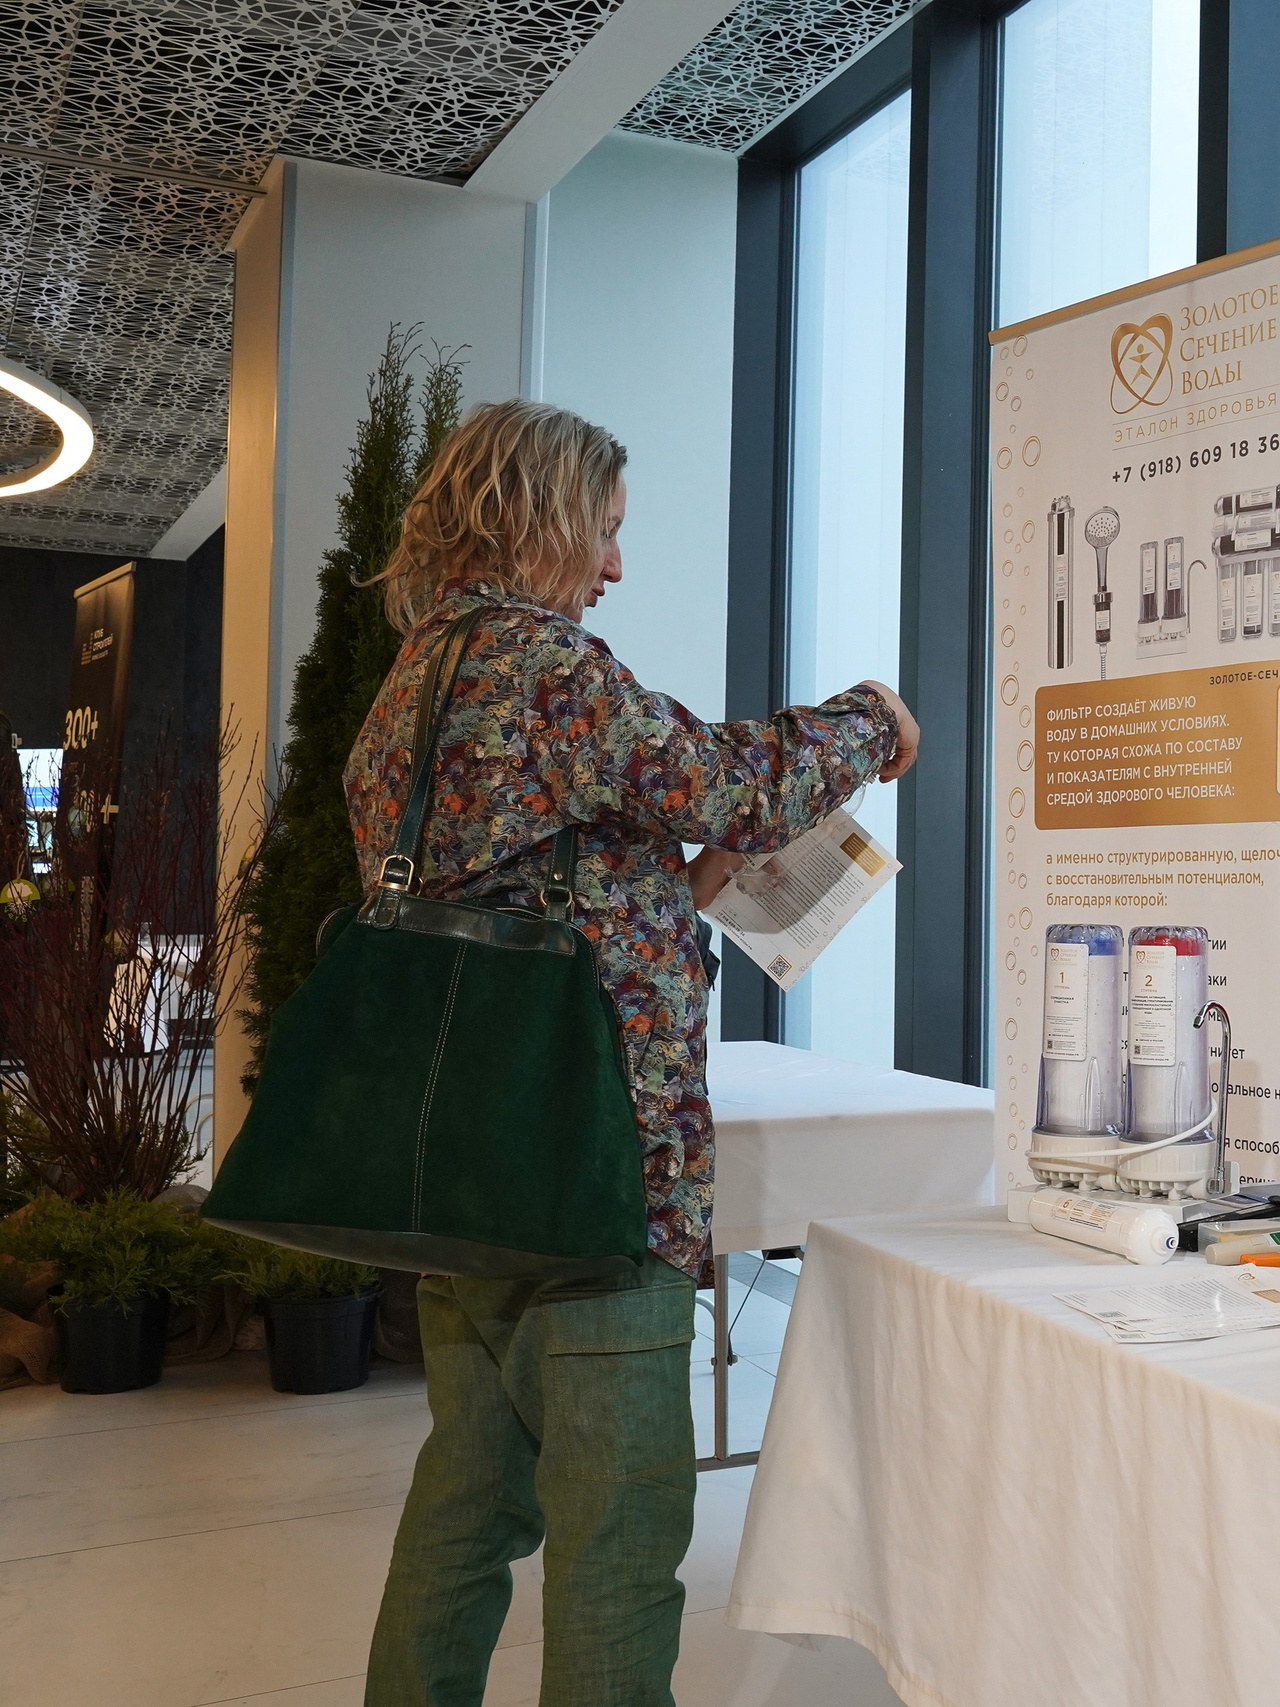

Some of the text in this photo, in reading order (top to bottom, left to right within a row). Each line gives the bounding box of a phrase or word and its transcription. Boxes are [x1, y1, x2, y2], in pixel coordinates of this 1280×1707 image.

[1181, 284, 1278, 331] ЗОЛОТОЕ
[1180, 318, 1277, 362] СЕЧЕНИЕ
[1182, 361, 1242, 394] ВОДЫ
[1114, 392, 1277, 442] ЭТАЛОН ЗДОРОВЬЯ
[1113, 434, 1280, 482] +7 (918) 609 18 36
[1047, 695, 1196, 722] ФИЛЬТР СОЗДАЁТ ЖИВУЮ
[1047, 714, 1229, 743] ВОДУ В ДОМАШНИХ УСЛОВИЯХ.
[1047, 737, 1242, 764] ТУ КОТОРАЯ СХОЖА ПО СОСТАВУ
[1047, 760, 1231, 785] И ПОКАЗАТЕЛЯМ С ВНУТРЕННЕЙ
[1047, 784, 1234, 806] СРЕДОЙ ЗДОРОВОГО ЧЕЛОВЕКА:
[1046, 854, 1052, 864] а
[1056, 852, 1103, 864] именно
[1107, 850, 1237, 866] структурированную,
[1046, 872, 1263, 886] с восстановительным потенциалом,
[1046, 894, 1167, 907] благодаря которой:
[1060, 972, 1064, 983] 1
[1145, 974, 1153, 986] 2
